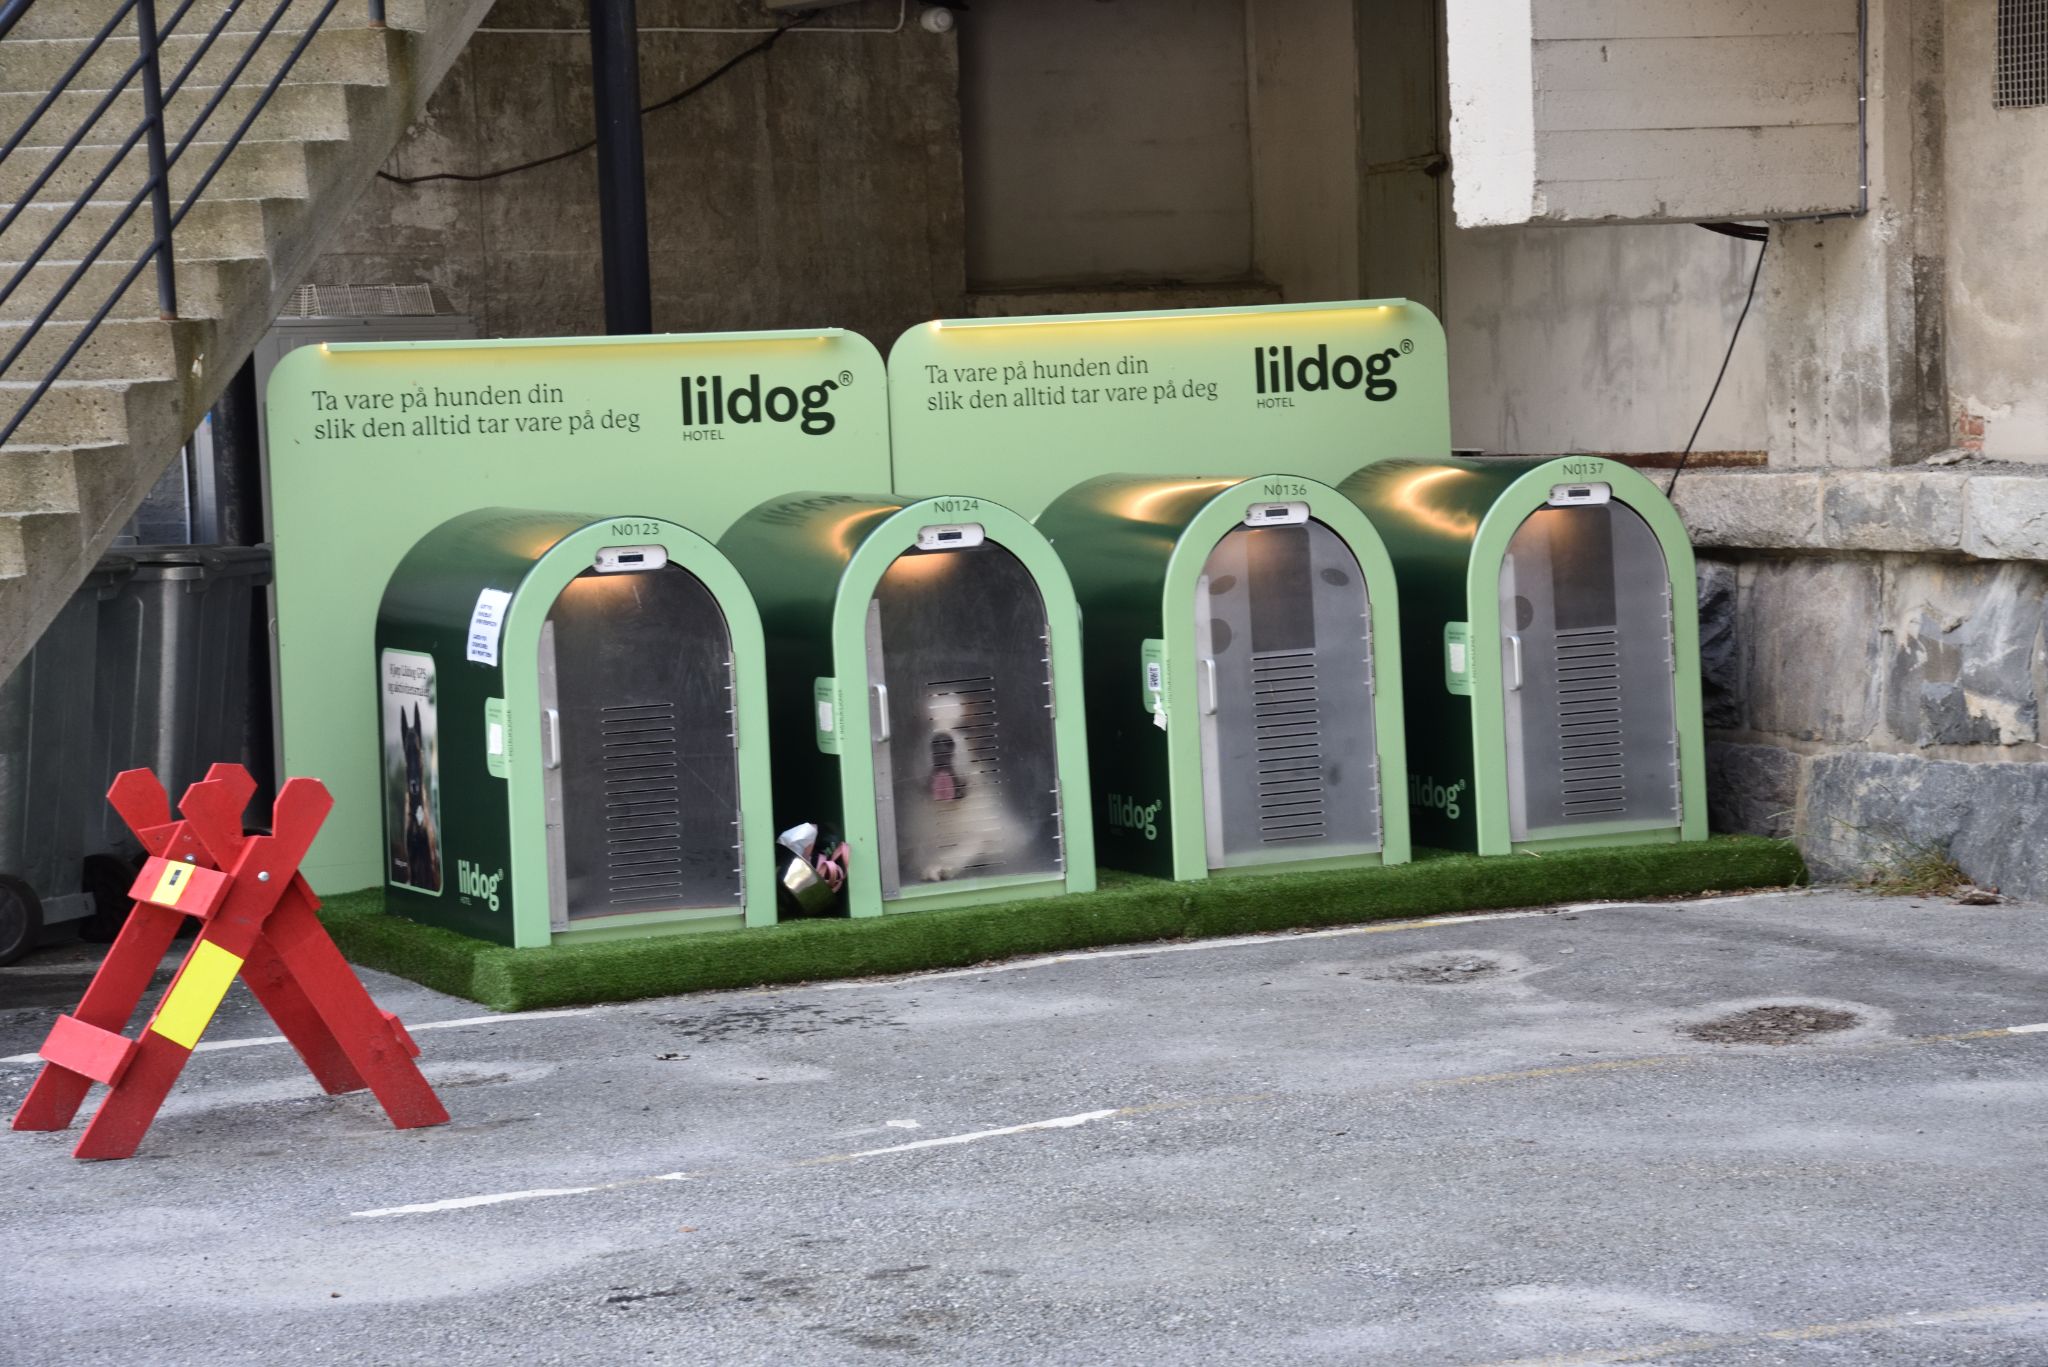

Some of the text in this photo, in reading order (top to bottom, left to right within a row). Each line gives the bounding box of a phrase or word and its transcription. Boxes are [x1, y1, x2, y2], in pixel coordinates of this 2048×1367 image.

[925, 355, 1149, 385] Ta vare på hunden din
[1255, 344, 1400, 402] lildog
[312, 383, 564, 413] Ta vare på hunden din
[681, 374, 839, 436] lildog
[927, 379, 1218, 411] slik den alltid tar vare på deg
[1257, 397, 1295, 409] HOTEL
[314, 408, 641, 439] slik den alltid tar vare på deg
[683, 430, 725, 442] HOTEL
[1108, 793, 1158, 840] lildog
[458, 859, 500, 911] lildog
